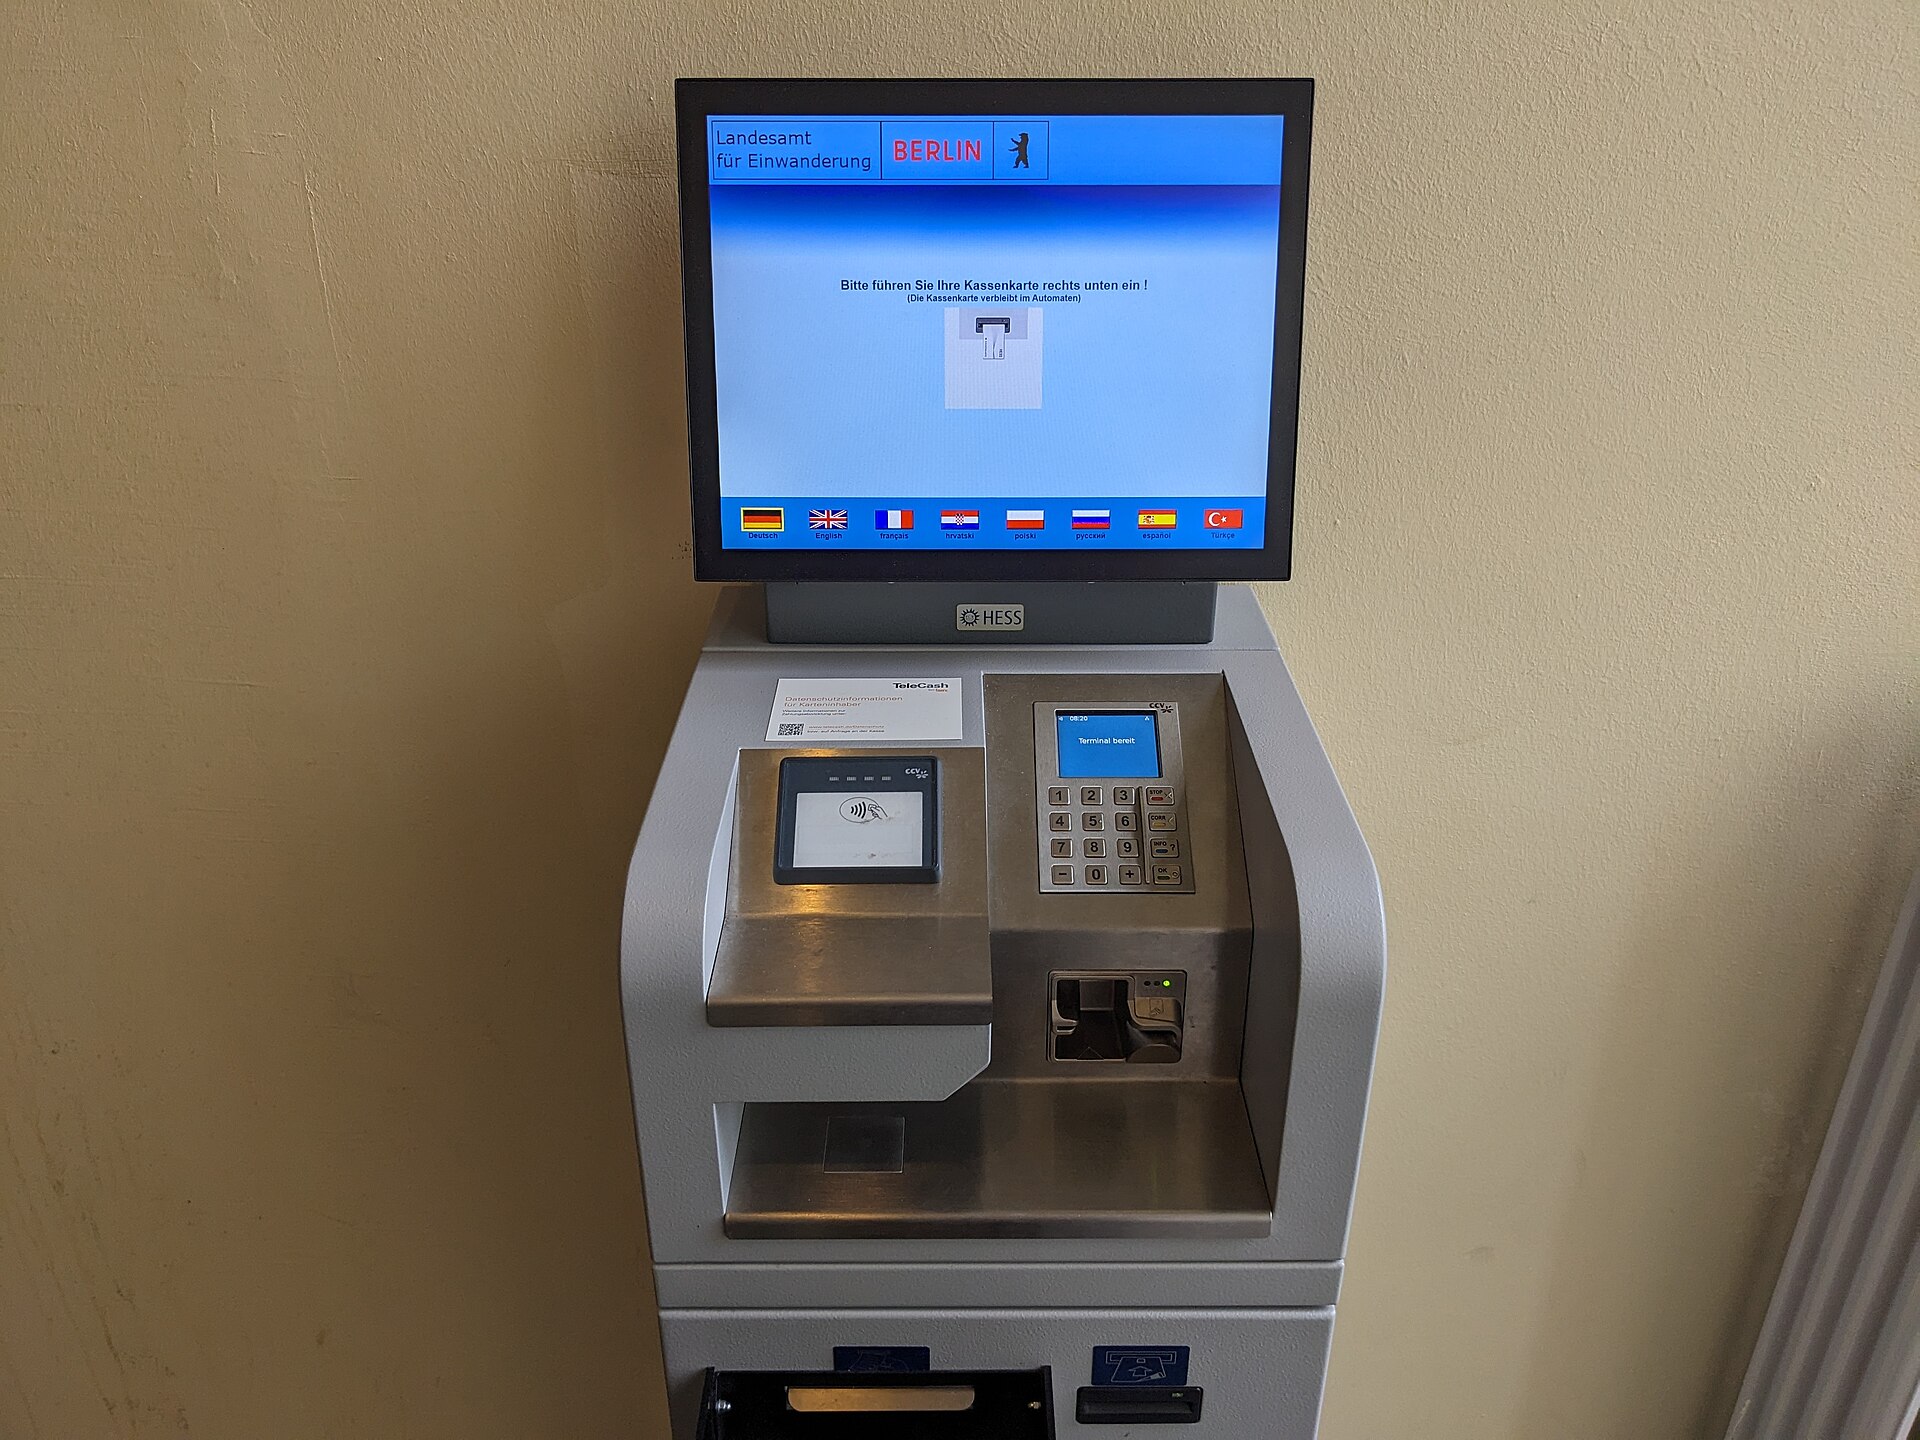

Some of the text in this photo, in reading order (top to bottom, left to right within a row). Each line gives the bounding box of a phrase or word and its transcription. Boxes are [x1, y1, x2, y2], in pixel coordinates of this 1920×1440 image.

[716, 130, 812, 146] Landesamt
[894, 140, 982, 161] BERLIN
[716, 153, 872, 172] für Einwanderung
[841, 279, 869, 291] Bitte
[872, 279, 911, 291] führen
[915, 279, 934, 291] Sie
[937, 279, 961, 291] Ihre
[964, 279, 1039, 291] Kassenkarte
[1042, 279, 1081, 291] rechts
[1084, 279, 1119, 291] unten
[1121, 279, 1140, 291] ein
[907, 294, 1081, 304] (Die Kassenkarte verbleibt im Automaten)
[815, 532, 843, 541] English
[879, 532, 909, 540] français
[1014, 532, 1037, 540] polski
[1075, 532, 1106, 541] русский
[1142, 531, 1171, 540] español
[1211, 531, 1235, 540] Türkçe
[983, 610, 1022, 625] HESS
[1055, 790, 1062, 801] 1
[1087, 790, 1096, 801] 2
[1119, 790, 1128, 801] 3
[1055, 816, 1064, 826] 4
[1089, 816, 1097, 826] 5
[1121, 816, 1130, 826] 6
[1057, 842, 1066, 852] 7
[1090, 842, 1099, 852] 8
[1123, 842, 1132, 852] 9
[1091, 869, 1101, 879] 0
